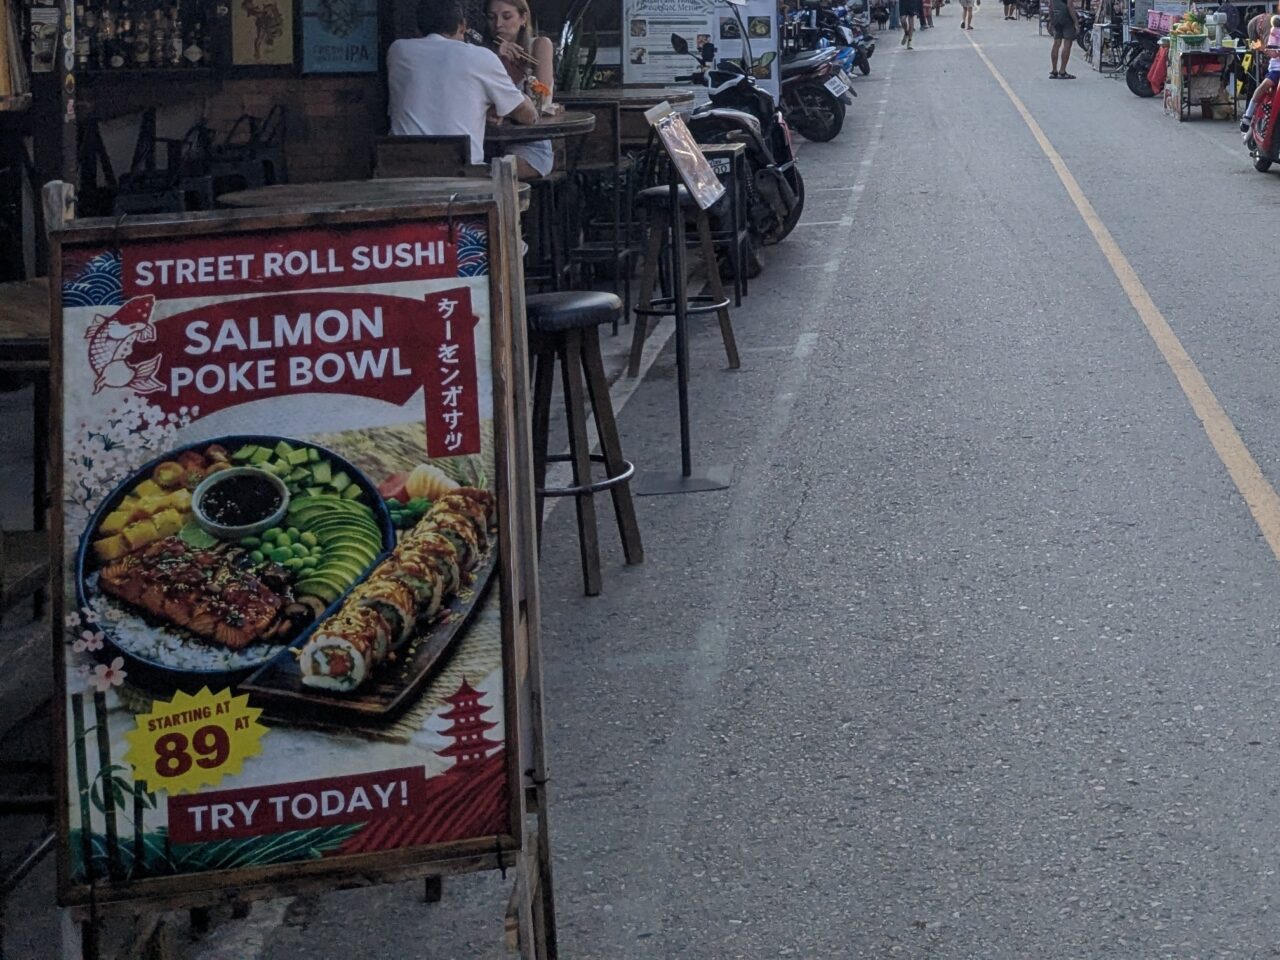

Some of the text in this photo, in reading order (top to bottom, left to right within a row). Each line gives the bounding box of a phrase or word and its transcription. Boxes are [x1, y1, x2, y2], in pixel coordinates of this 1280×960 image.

[345, 44, 369, 61] IPA
[134, 240, 445, 287] STREET ROLL SUSHI
[184, 306, 384, 356] SALMON
[170, 348, 412, 397] POKE BOWL
[147, 699, 231, 733] STARTING AT
[234, 715, 251, 731] AT
[154, 725, 231, 778] 89
[188, 780, 409, 833] TRY TODAY!
